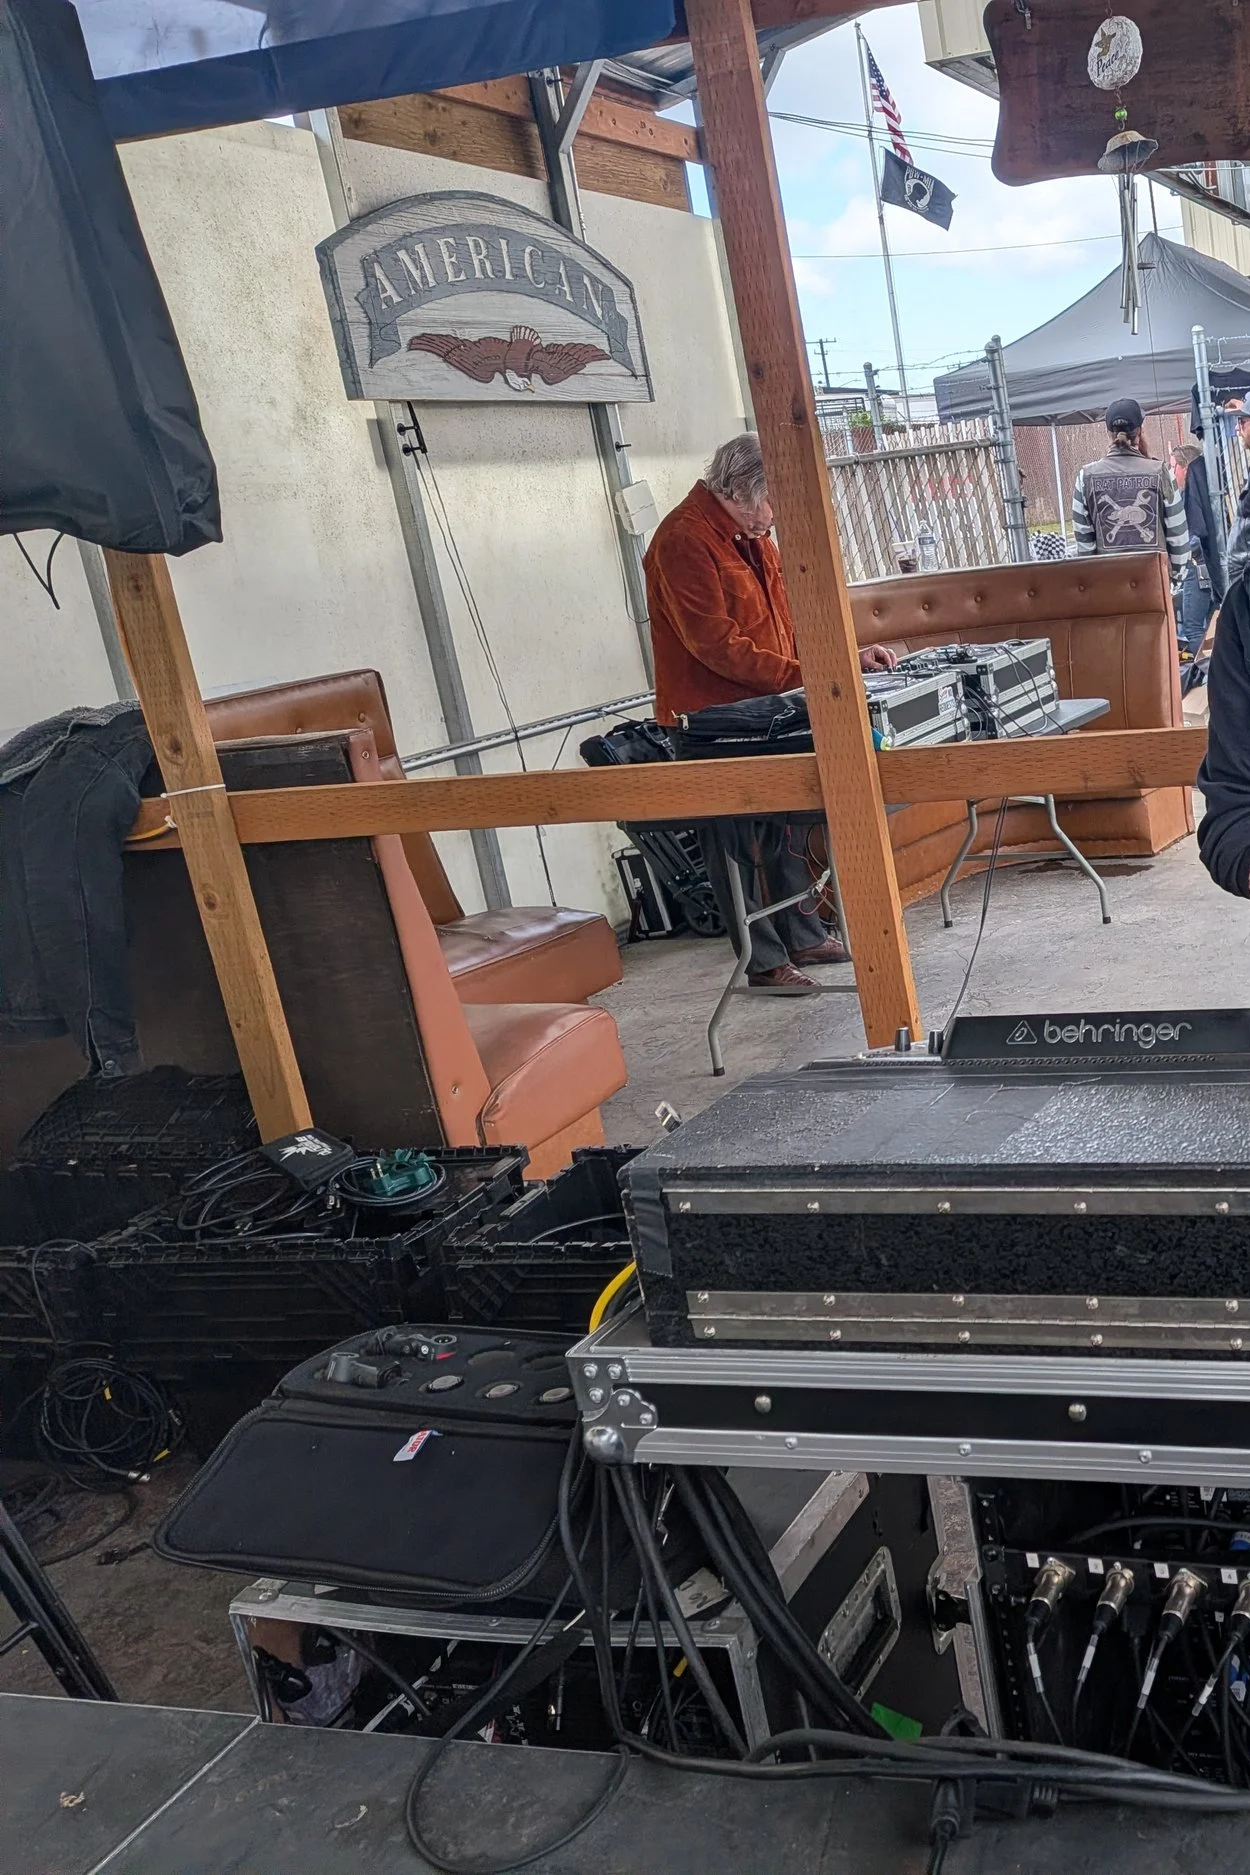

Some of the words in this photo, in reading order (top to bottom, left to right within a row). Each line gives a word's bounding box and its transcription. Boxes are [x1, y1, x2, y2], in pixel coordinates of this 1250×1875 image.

[373, 236, 605, 320] AMERICAN
[1095, 480, 1115, 491] RAT
[1117, 476, 1157, 489] PATROL
[1043, 1018, 1193, 1049] behringer
[407, 1431, 428, 1453] ATOR
